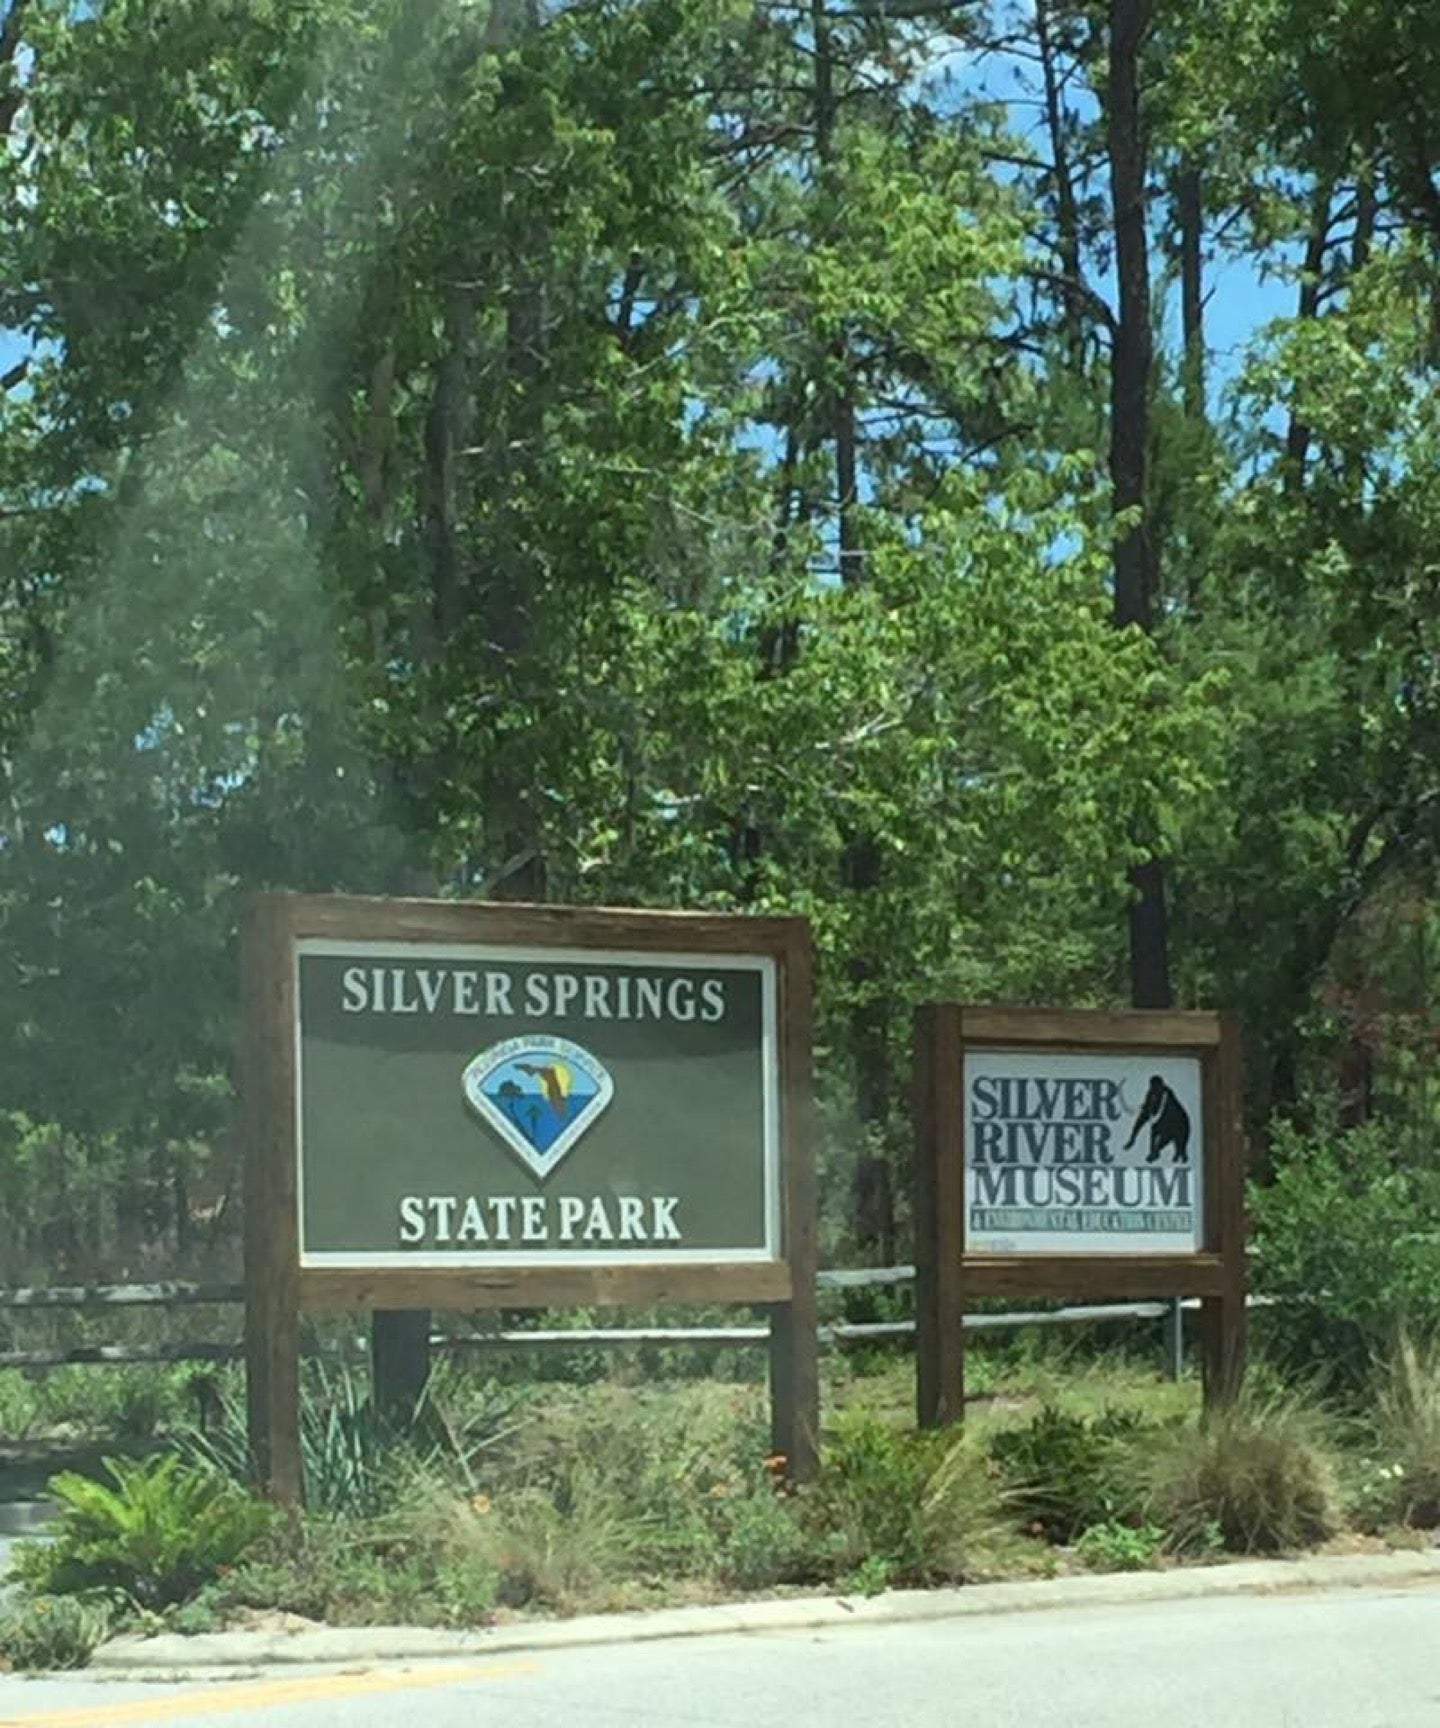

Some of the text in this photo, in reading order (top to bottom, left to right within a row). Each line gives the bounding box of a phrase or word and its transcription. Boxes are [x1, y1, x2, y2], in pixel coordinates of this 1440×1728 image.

[343, 967, 725, 1020] SILVER SPRINGS
[971, 1075, 1121, 1121] SILVER
[972, 1122, 1114, 1164] RIVER
[971, 1164, 1191, 1207] MUSEUM
[400, 1196, 682, 1242] STATE PARK
